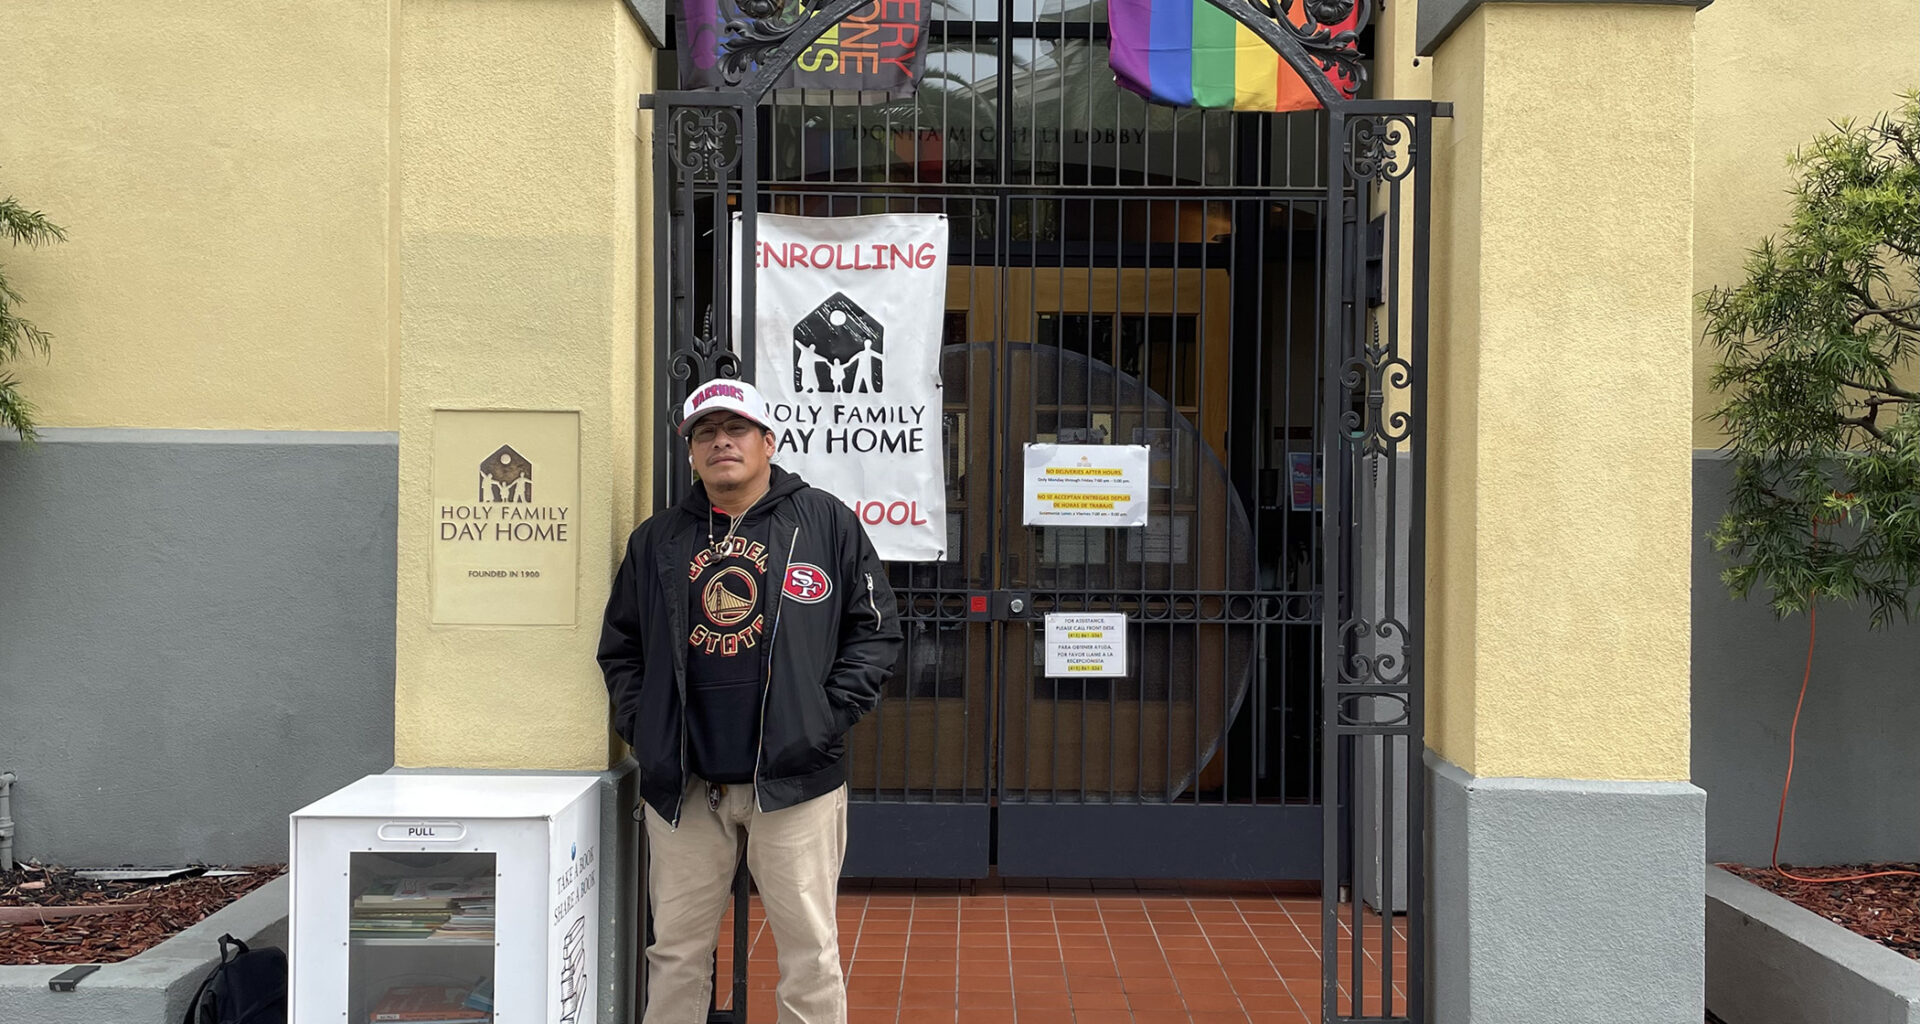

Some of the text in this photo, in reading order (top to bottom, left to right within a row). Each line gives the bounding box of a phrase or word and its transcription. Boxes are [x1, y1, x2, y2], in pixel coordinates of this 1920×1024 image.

[852, 127, 940, 142] DONNA
[1073, 128, 1147, 145] LOBBY
[692, 384, 744, 410] WARRIORS
[765, 402, 926, 425] OLY FAMILY
[826, 428, 925, 454] HOME
[441, 506, 569, 521] HOLY FAMILY
[441, 522, 568, 542] DAY HOME
[791, 568, 822, 598] SF
[408, 827, 435, 837] PULL
[557, 866, 573, 895] TAKE
[579, 846, 594, 874] BOOK
[554, 891, 574, 926] SHARE
[580, 870, 596, 898] BOOK
